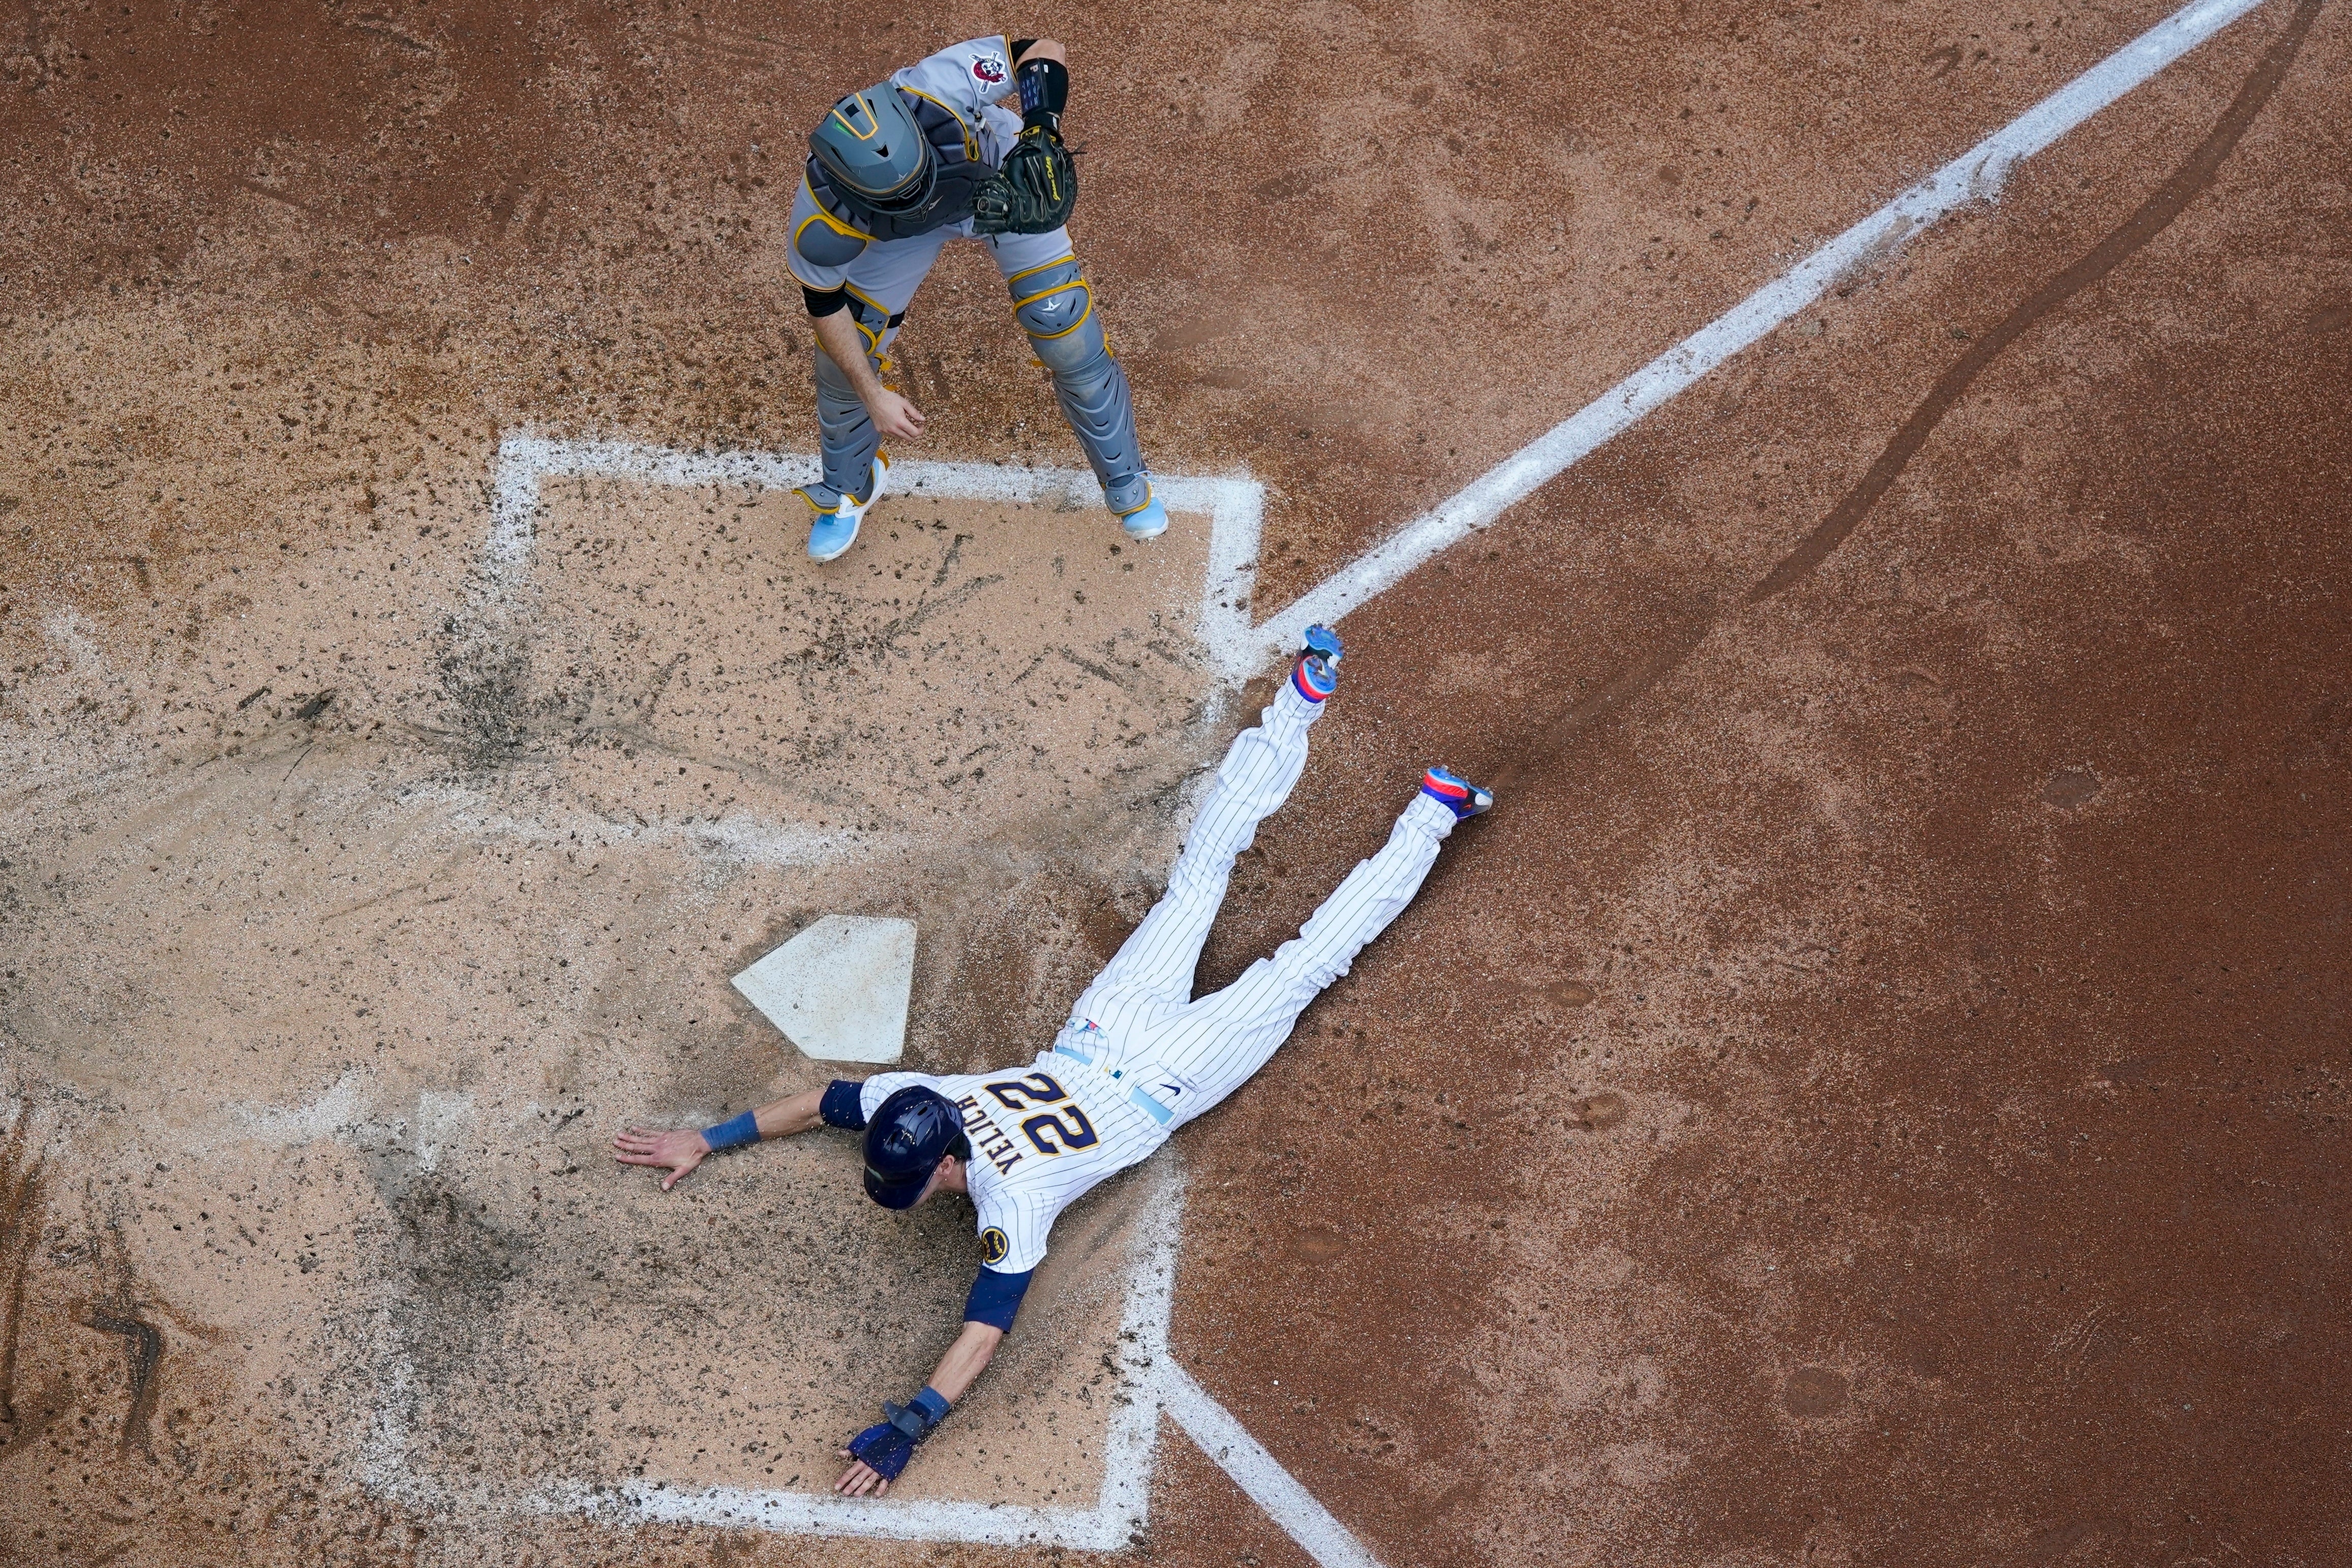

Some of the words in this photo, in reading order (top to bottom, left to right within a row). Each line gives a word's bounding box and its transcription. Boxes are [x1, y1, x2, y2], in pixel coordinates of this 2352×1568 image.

[1051, 178, 1061, 201] Jason
[955, 1095, 1023, 1176] YELICH
[982, 1072, 1100, 1156] 22
